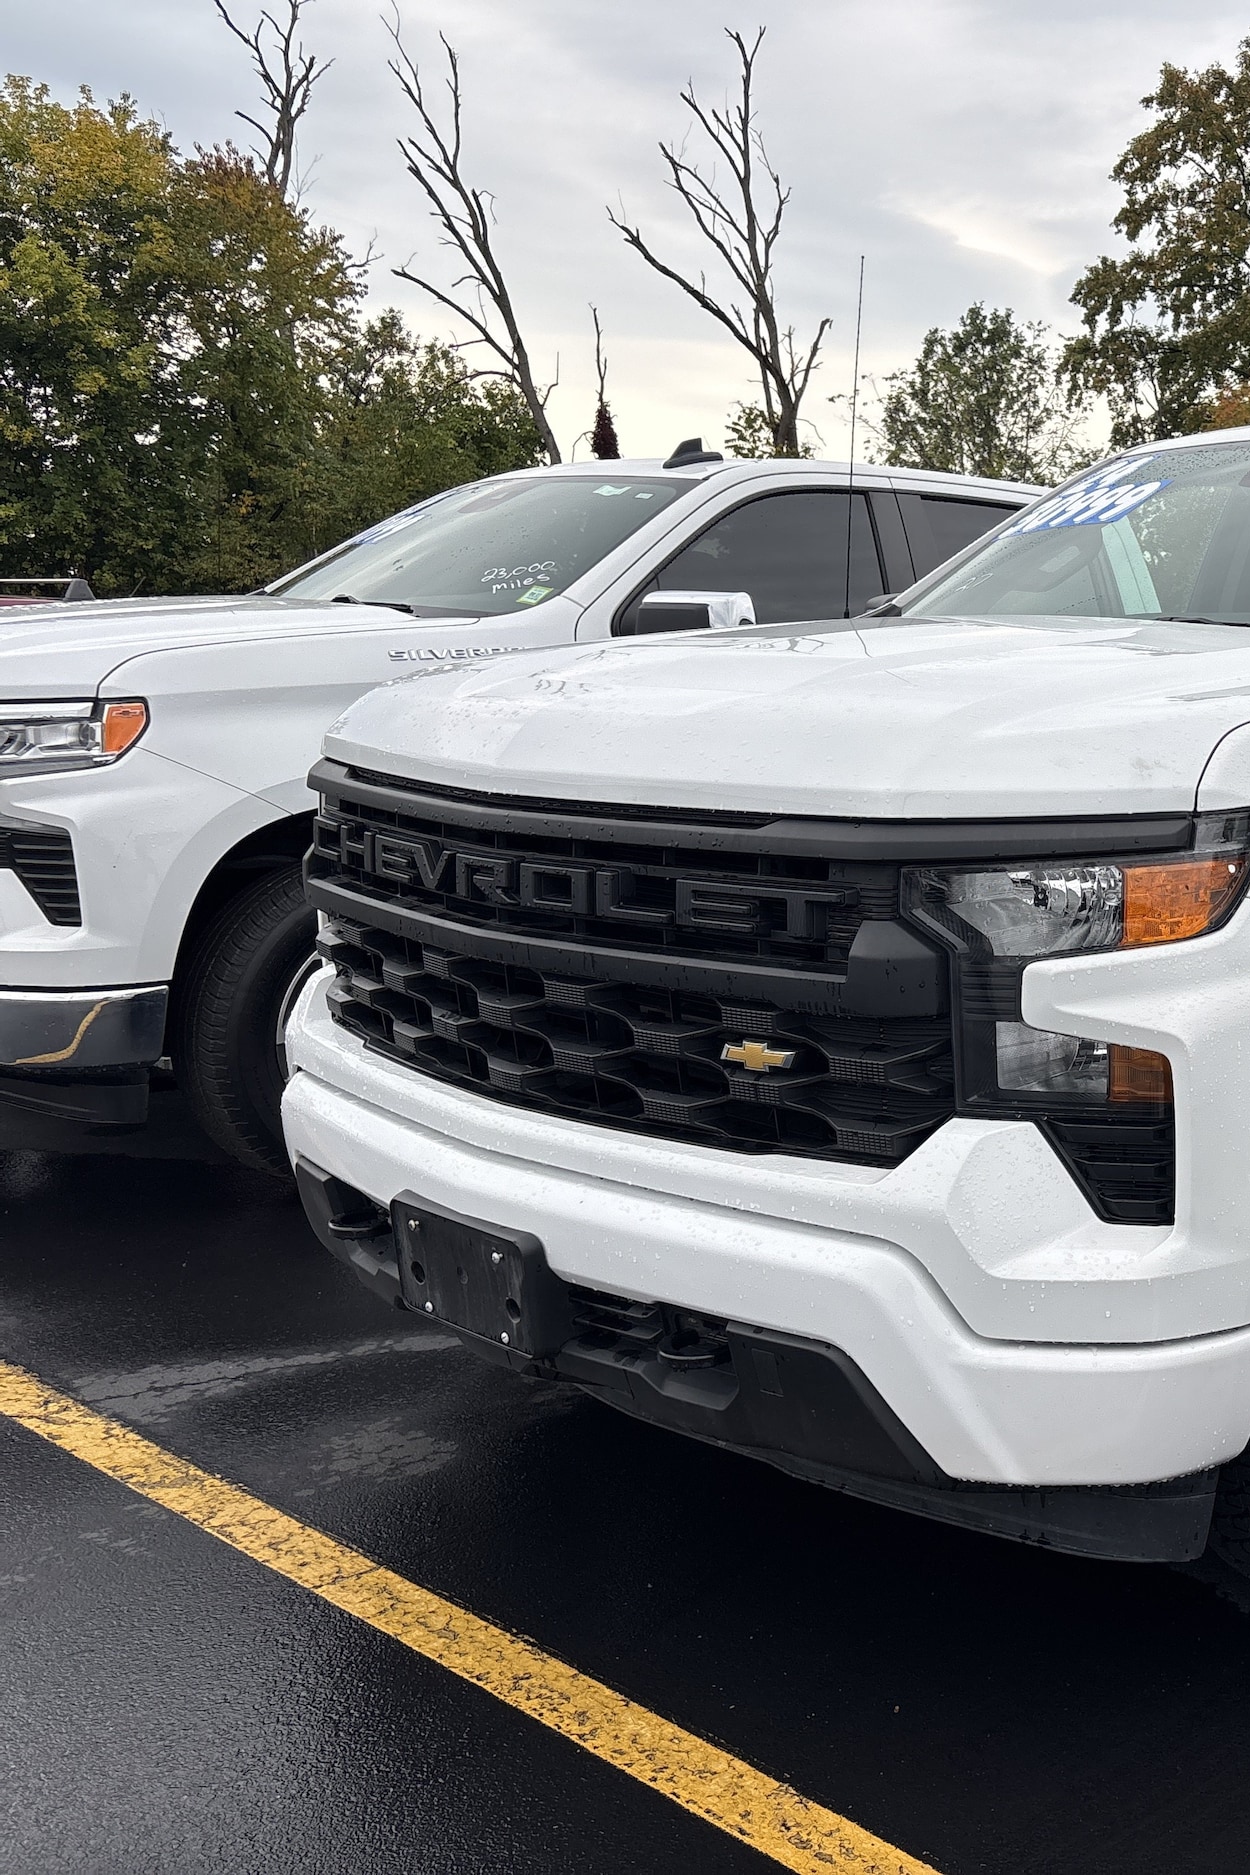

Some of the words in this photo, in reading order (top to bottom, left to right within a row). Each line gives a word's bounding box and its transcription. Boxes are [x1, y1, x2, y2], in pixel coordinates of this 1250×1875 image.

[481, 561, 555, 582] 23,000
[492, 573, 550, 594] miles
[312, 814, 860, 941] CHEVROLET
